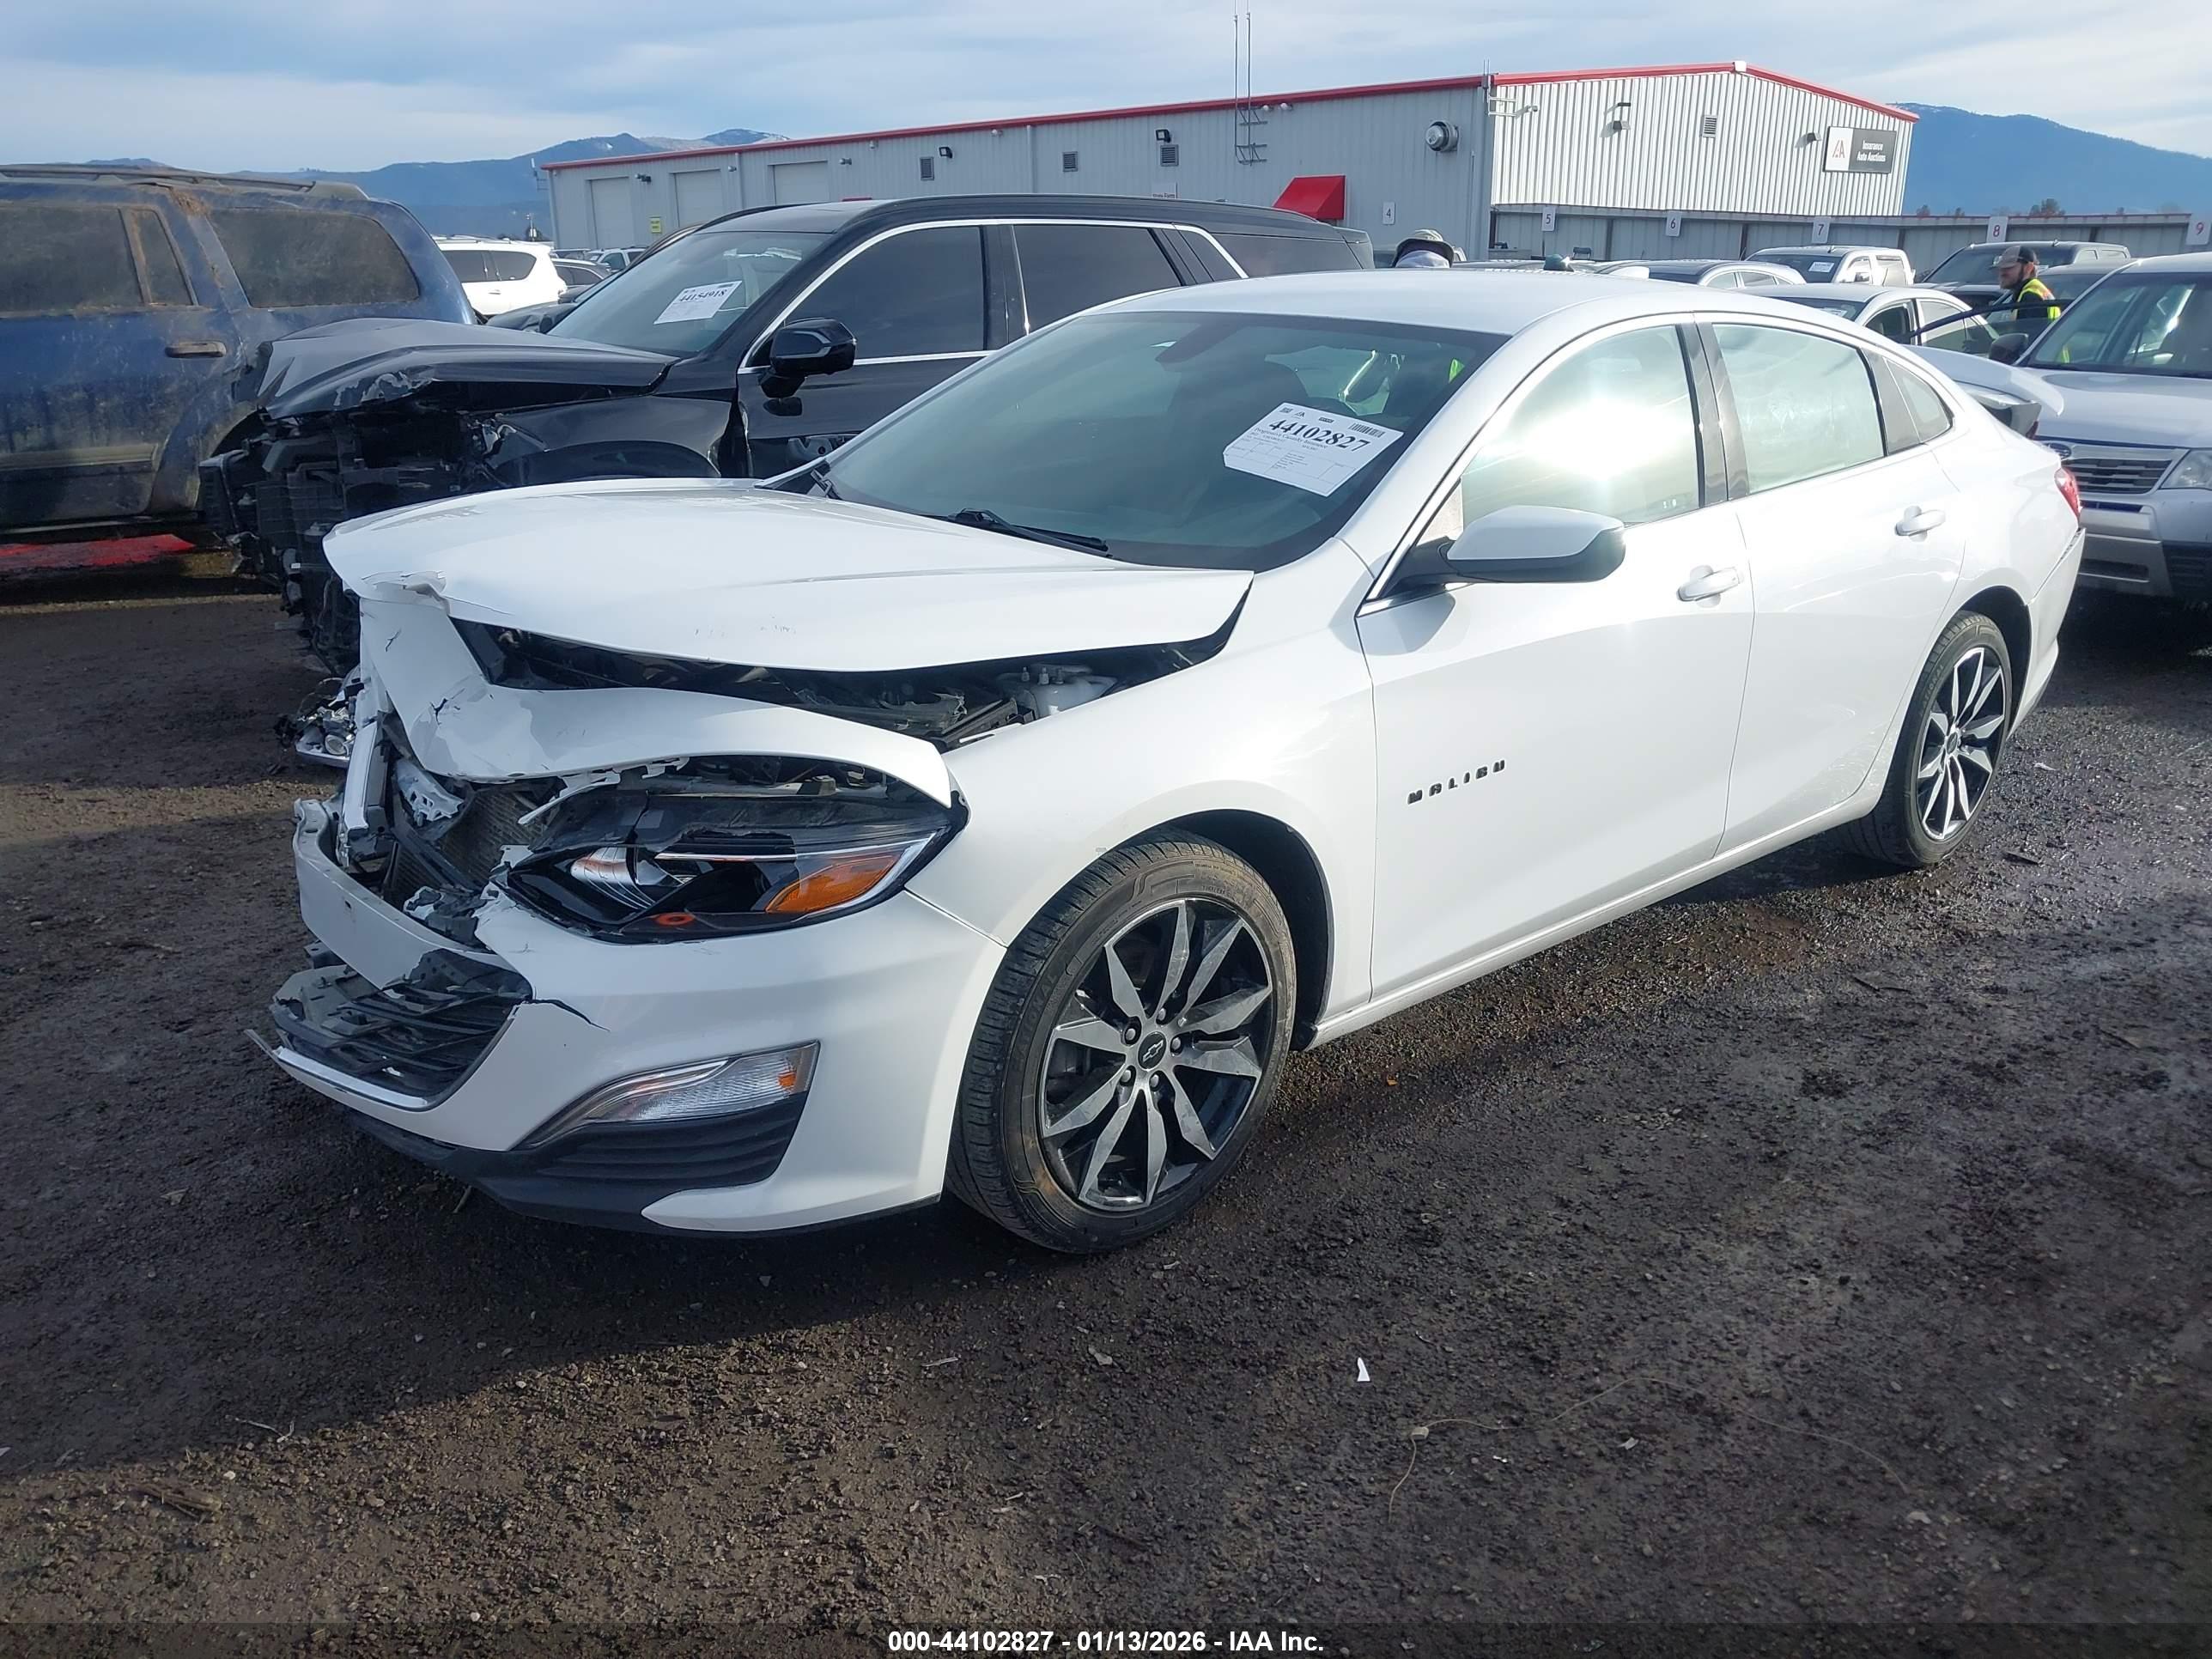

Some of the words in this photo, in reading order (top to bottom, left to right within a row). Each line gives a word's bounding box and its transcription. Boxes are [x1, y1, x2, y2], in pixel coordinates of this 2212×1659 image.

[1856, 150, 1868, 161] Auto
[1386, 208, 1391, 219] 4
[1545, 214, 1552, 225] 5
[1670, 217, 1677, 229] 6
[1817, 223, 1825, 236] 7
[2195, 222, 2204, 235] 9
[1992, 224, 2001, 238] 8
[1268, 419, 1371, 452] 44102827
[1407, 759, 1505, 805] MALIBU
